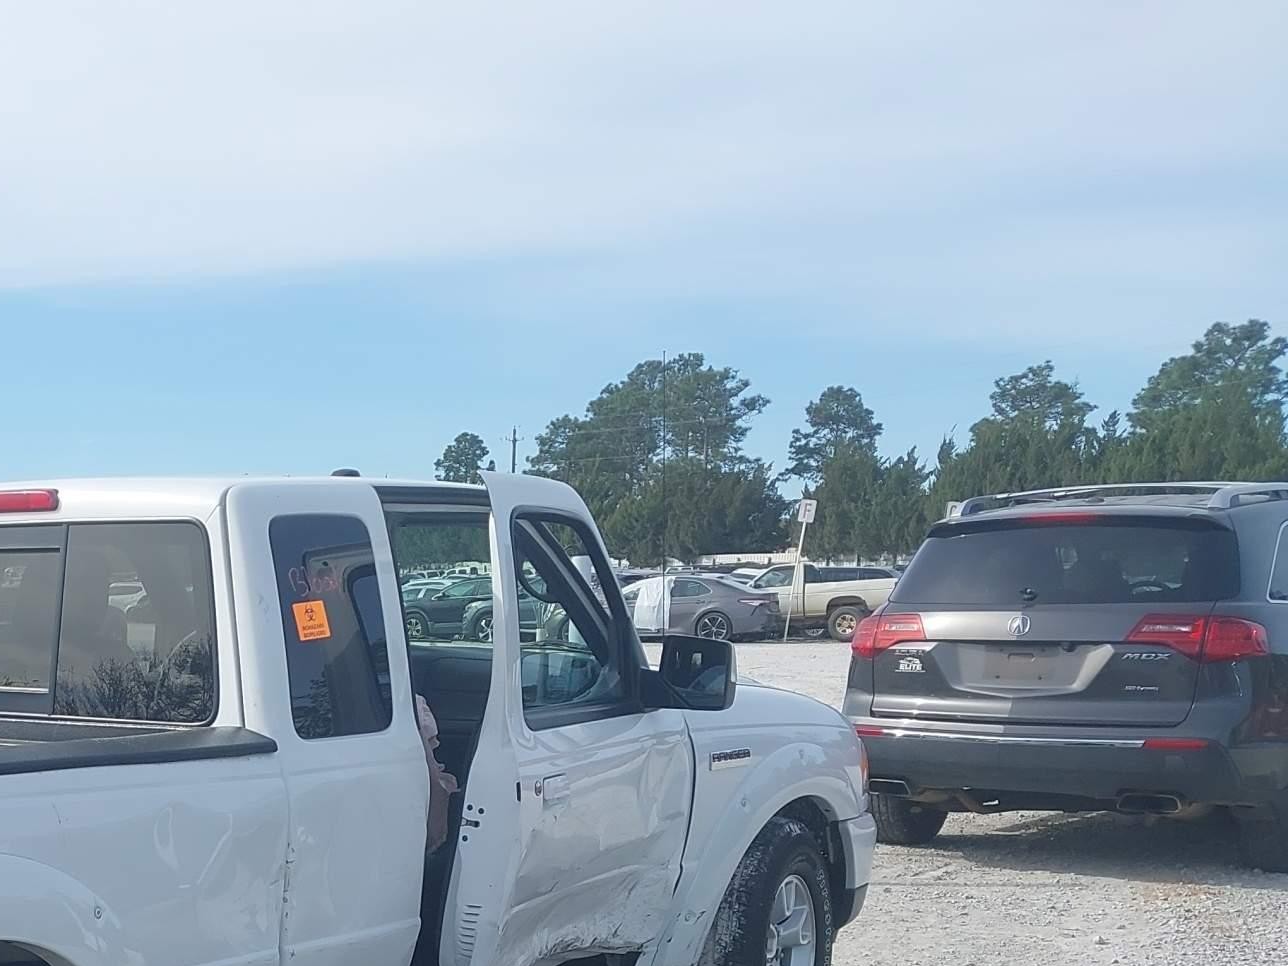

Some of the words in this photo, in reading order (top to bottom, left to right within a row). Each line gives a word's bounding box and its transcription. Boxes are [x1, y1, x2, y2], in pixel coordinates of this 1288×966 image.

[803, 502, 812, 519] F
[1121, 652, 1172, 661] MDX
[899, 663, 923, 671] ELITE
[712, 748, 751, 763] RANGER
